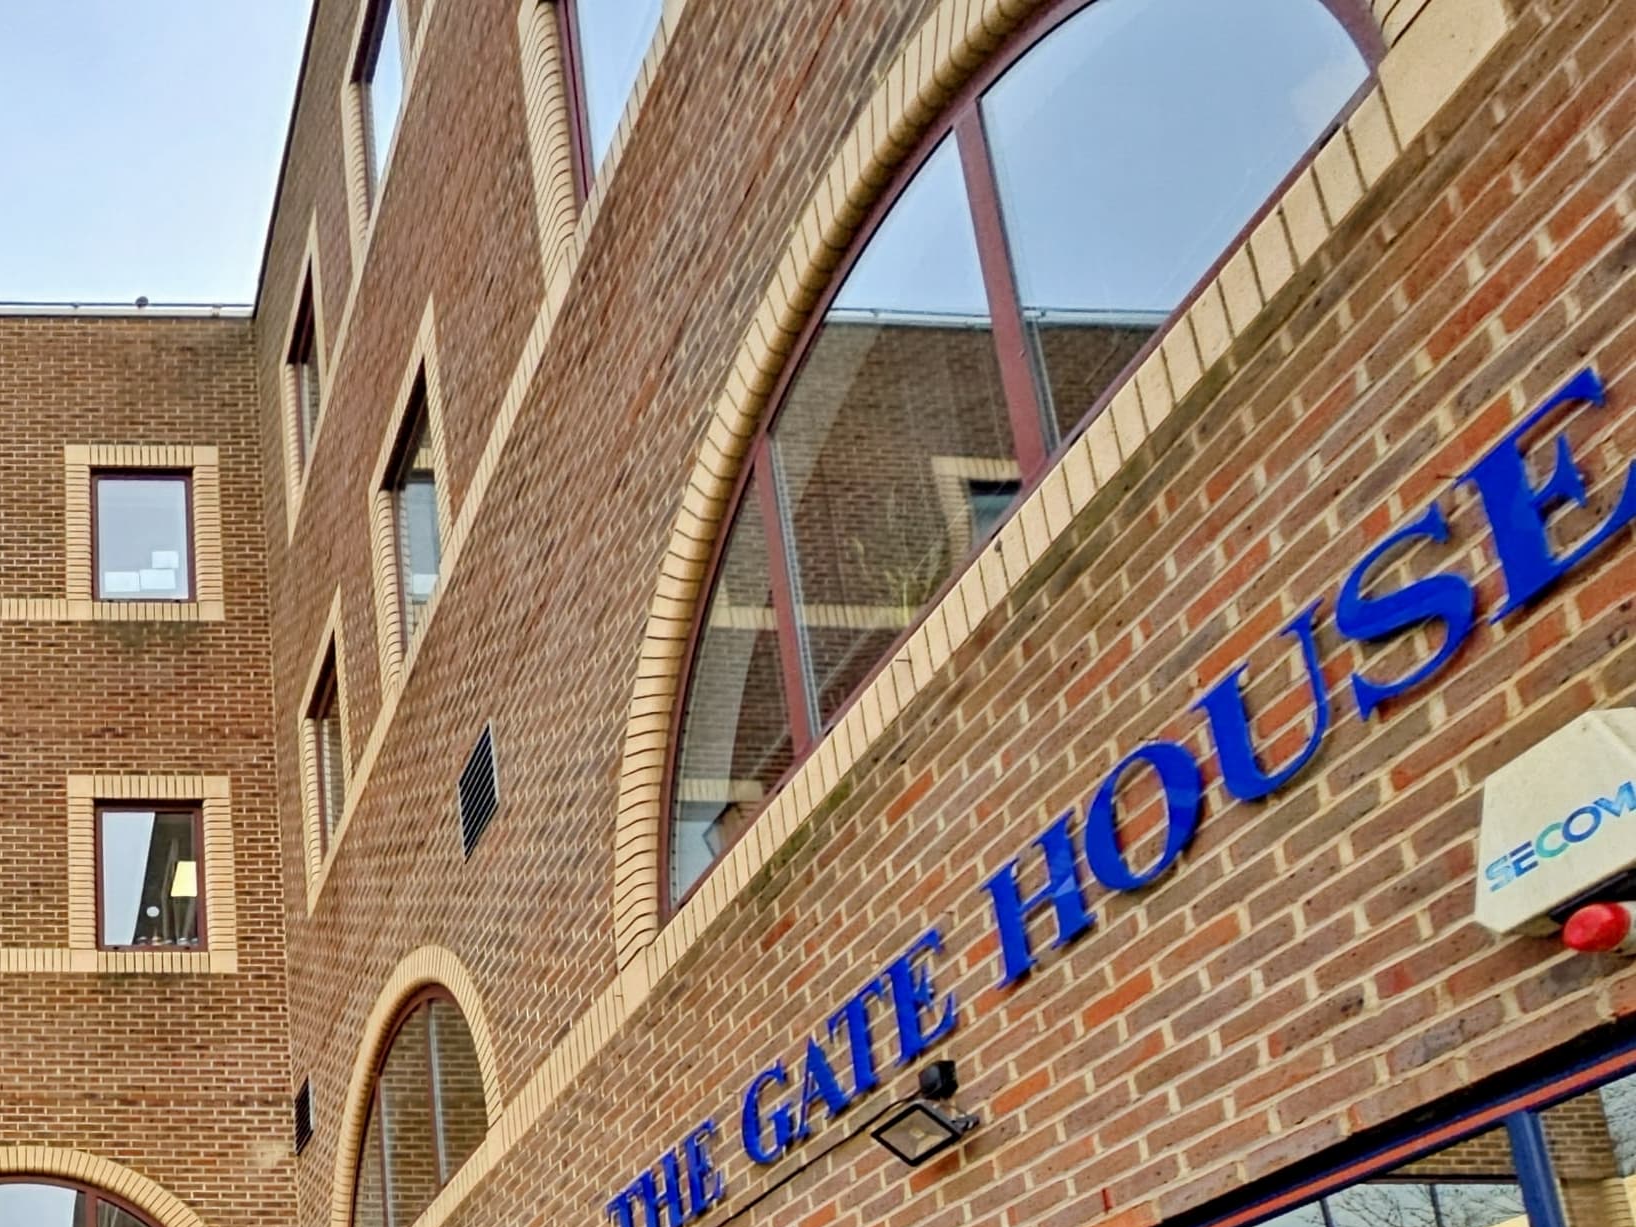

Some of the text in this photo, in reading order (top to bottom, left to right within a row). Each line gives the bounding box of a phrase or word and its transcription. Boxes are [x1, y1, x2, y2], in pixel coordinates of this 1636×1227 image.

[742, 928, 957, 1165] GATE
[981, 366, 1636, 990] HOUSE
[1485, 781, 1636, 892] SECOM
